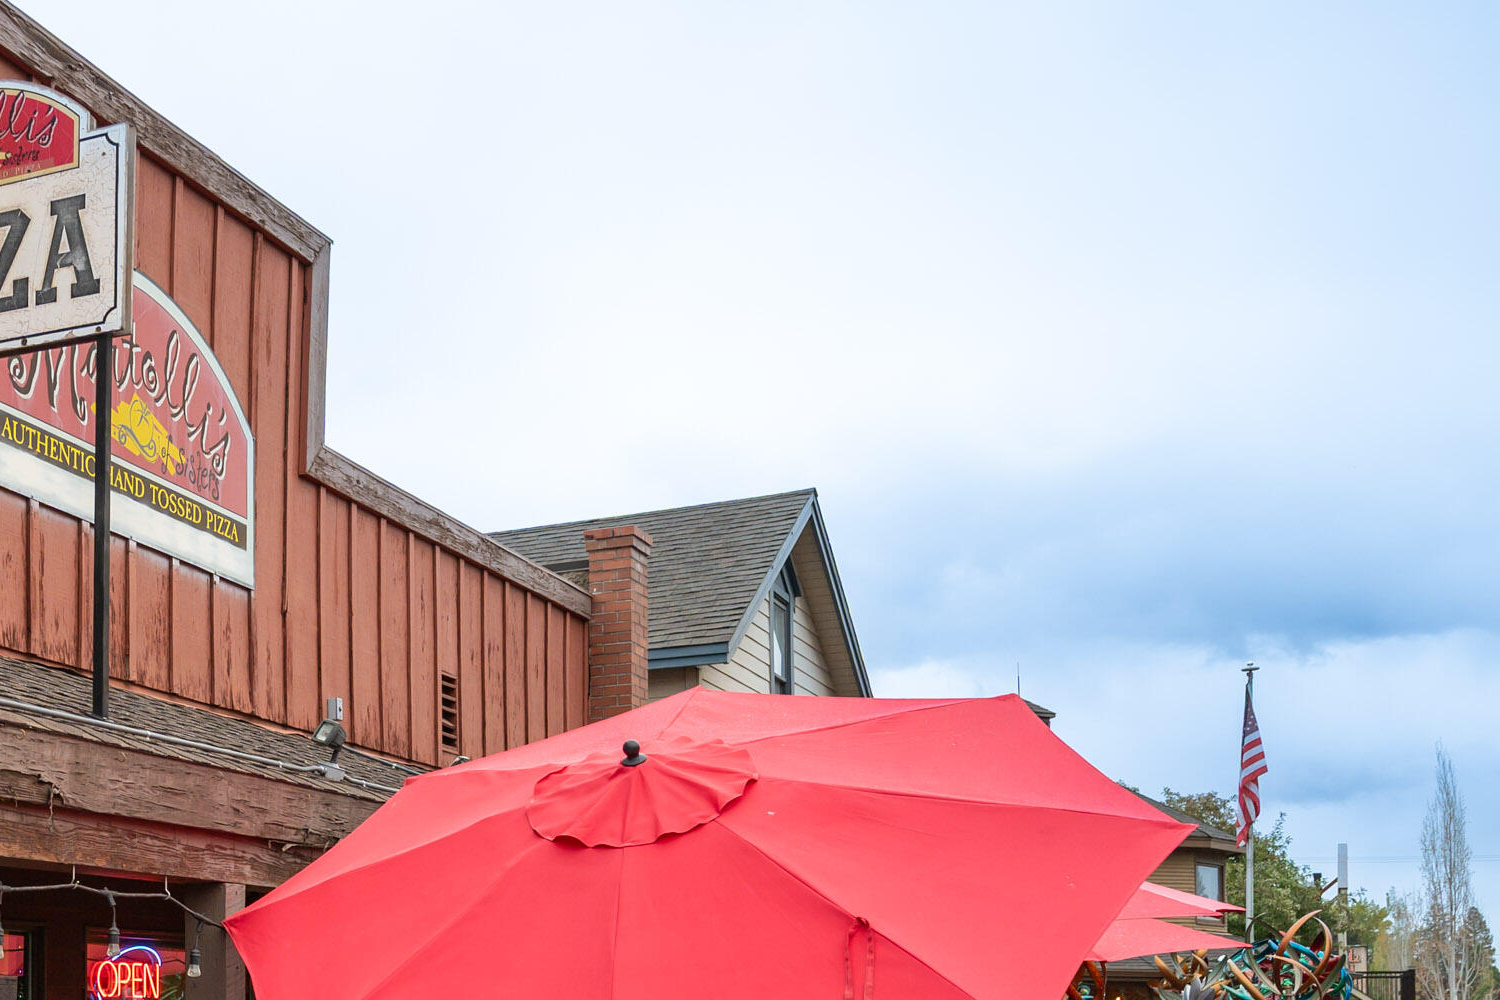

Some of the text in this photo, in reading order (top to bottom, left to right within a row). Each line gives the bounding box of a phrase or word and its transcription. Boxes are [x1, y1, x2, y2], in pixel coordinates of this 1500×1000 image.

[1, 416, 239, 543] AUTHENTIC AND TOSSED PIZZA
[161, 434, 219, 501] of Sisters
[97, 960, 160, 999] OPEN
